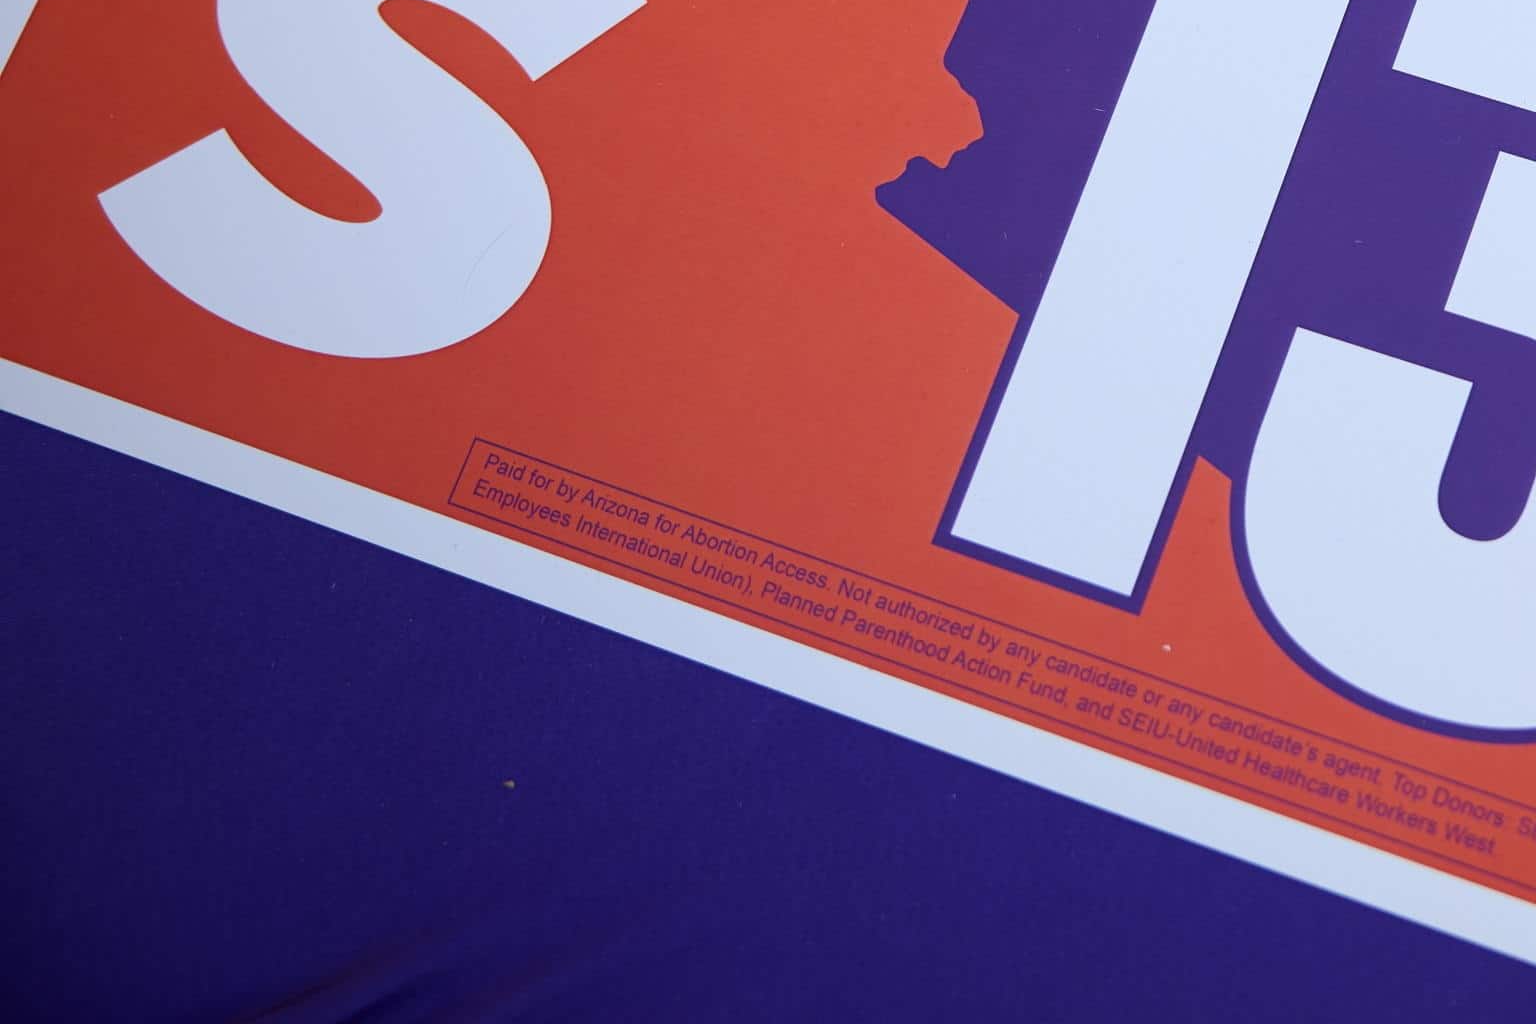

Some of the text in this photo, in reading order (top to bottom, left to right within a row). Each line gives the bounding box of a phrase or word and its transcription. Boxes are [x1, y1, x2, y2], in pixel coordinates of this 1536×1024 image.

[472, 478, 571, 528] Employees
[575, 515, 687, 569] International
[761, 580, 838, 622] Planned
[841, 609, 950, 662] Parenthood
[951, 651, 1012, 685] Action
[1076, 696, 1115, 721] and
[1118, 708, 1241, 763] SEIU-United
[1243, 751, 1350, 804] Healthcare
[1356, 791, 1438, 835] Workers
[1445, 823, 1497, 854] West
[484, 453, 527, 481] Paid
[528, 469, 554, 491] for
[556, 479, 580, 503] by
[581, 489, 650, 526] Arizona
[654, 513, 681, 535] for
[681, 524, 759, 568] Abortion
[760, 552, 832, 592] Access.
[837, 578, 872, 605] Not
[875, 594, 976, 642] authorized
[977, 628, 1001, 653] by
[1005, 641, 1042, 667] any
[1045, 654, 1138, 698] candidate
[1143, 688, 1166, 706] or
[1167, 697, 1202, 723] any
[1393, 771, 1428, 801] Top
